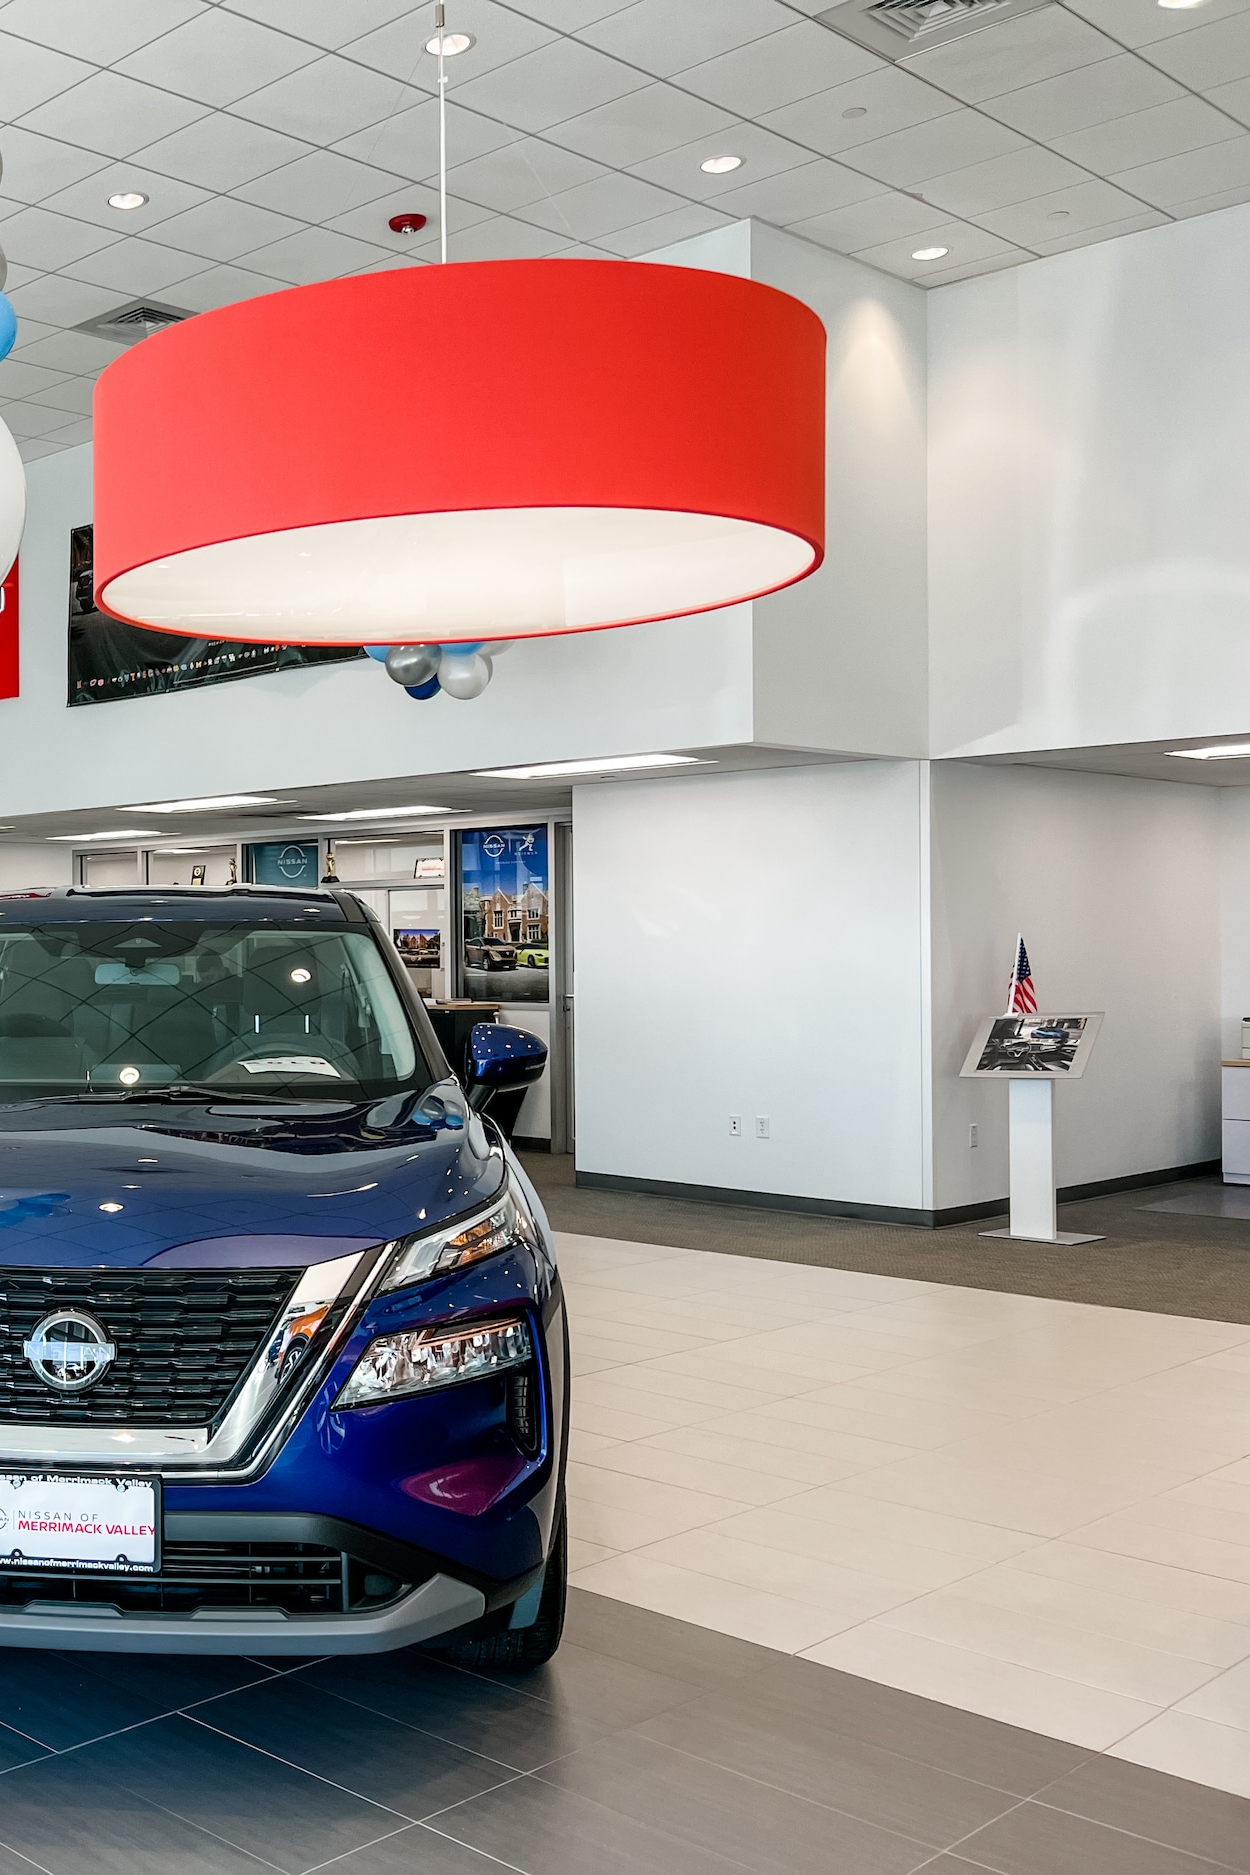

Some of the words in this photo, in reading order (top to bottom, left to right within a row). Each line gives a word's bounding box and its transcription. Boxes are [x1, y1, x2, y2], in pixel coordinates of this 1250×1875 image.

[277, 857, 308, 865] NISSAN
[27, 1345, 112, 1361] NISSAN
[46, 1475, 112, 1485] Merrimack
[115, 1478, 152, 1488] Valley
[18, 1510, 72, 1521] NISSAN
[80, 1513, 99, 1522] OF
[18, 1520, 102, 1534] MERRIMACK
[105, 1524, 155, 1536] VALLEY
